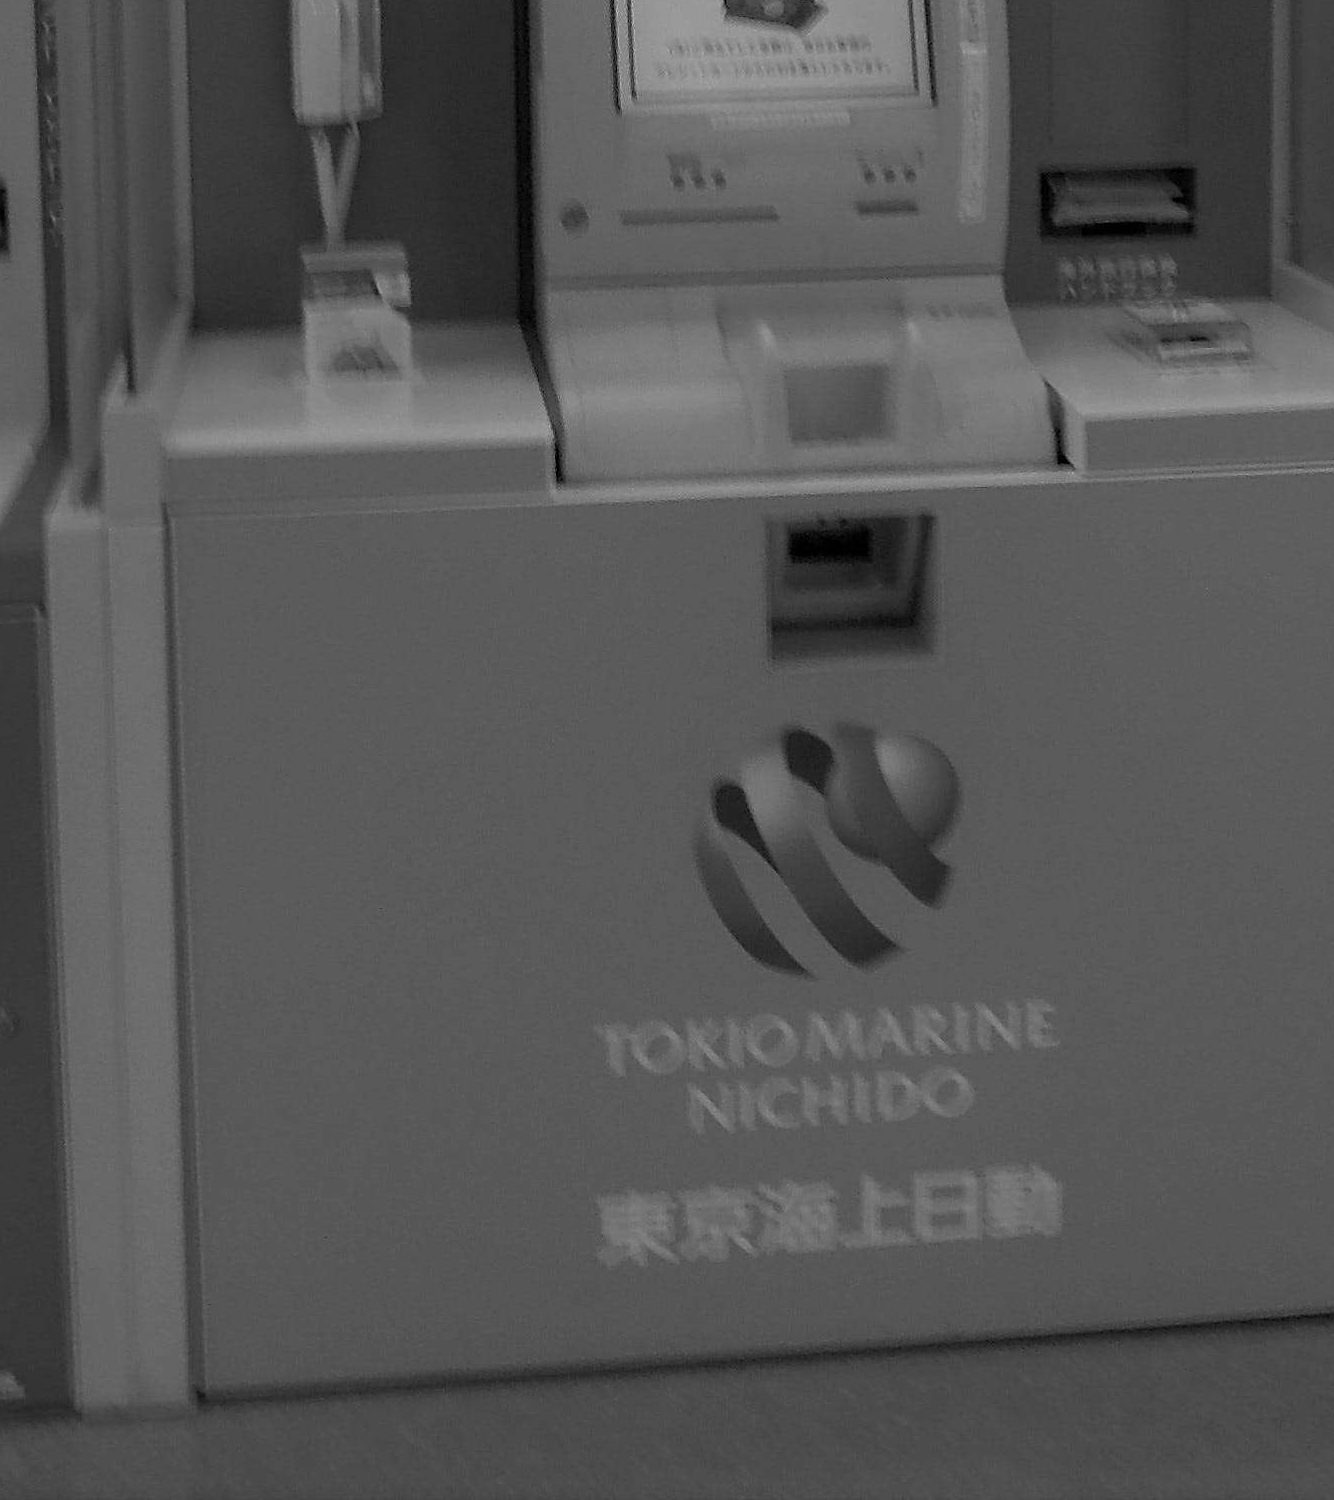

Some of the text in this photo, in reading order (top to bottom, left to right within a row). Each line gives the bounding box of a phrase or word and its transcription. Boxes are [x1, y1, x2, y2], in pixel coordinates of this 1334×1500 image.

[595, 998, 1061, 1077] TOKIO MARINE
[687, 1066, 975, 1135] NICHIDO
[596, 1162, 1063, 1268] 東京海上日動
